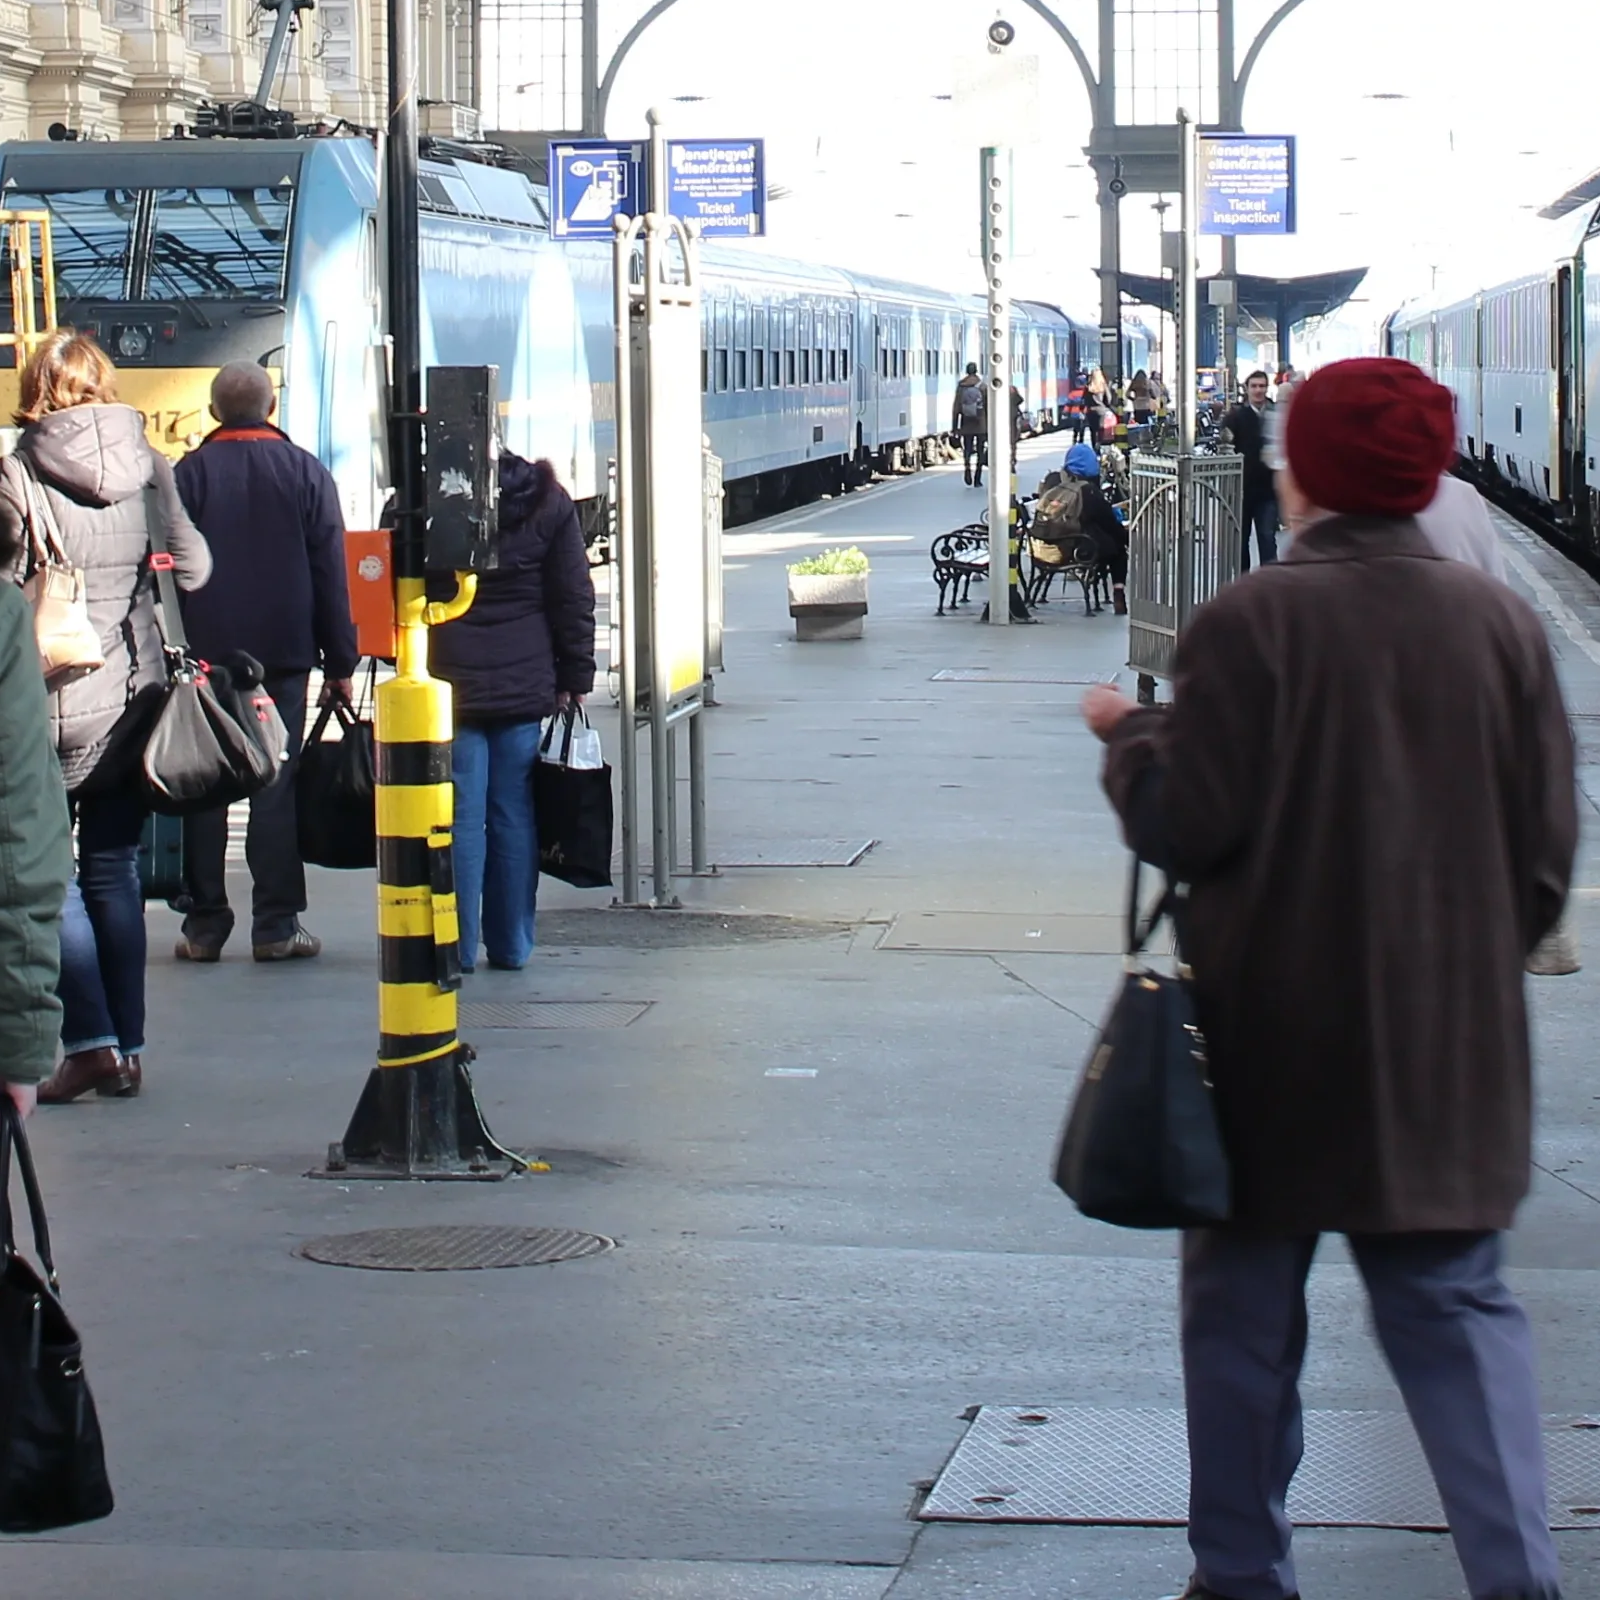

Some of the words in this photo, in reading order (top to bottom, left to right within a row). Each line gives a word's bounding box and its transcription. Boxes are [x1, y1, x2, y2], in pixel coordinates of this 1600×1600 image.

[696, 201, 735, 214] Ticket
[1228, 198, 1267, 211] Ticket
[1213, 211, 1281, 226] inspection!
